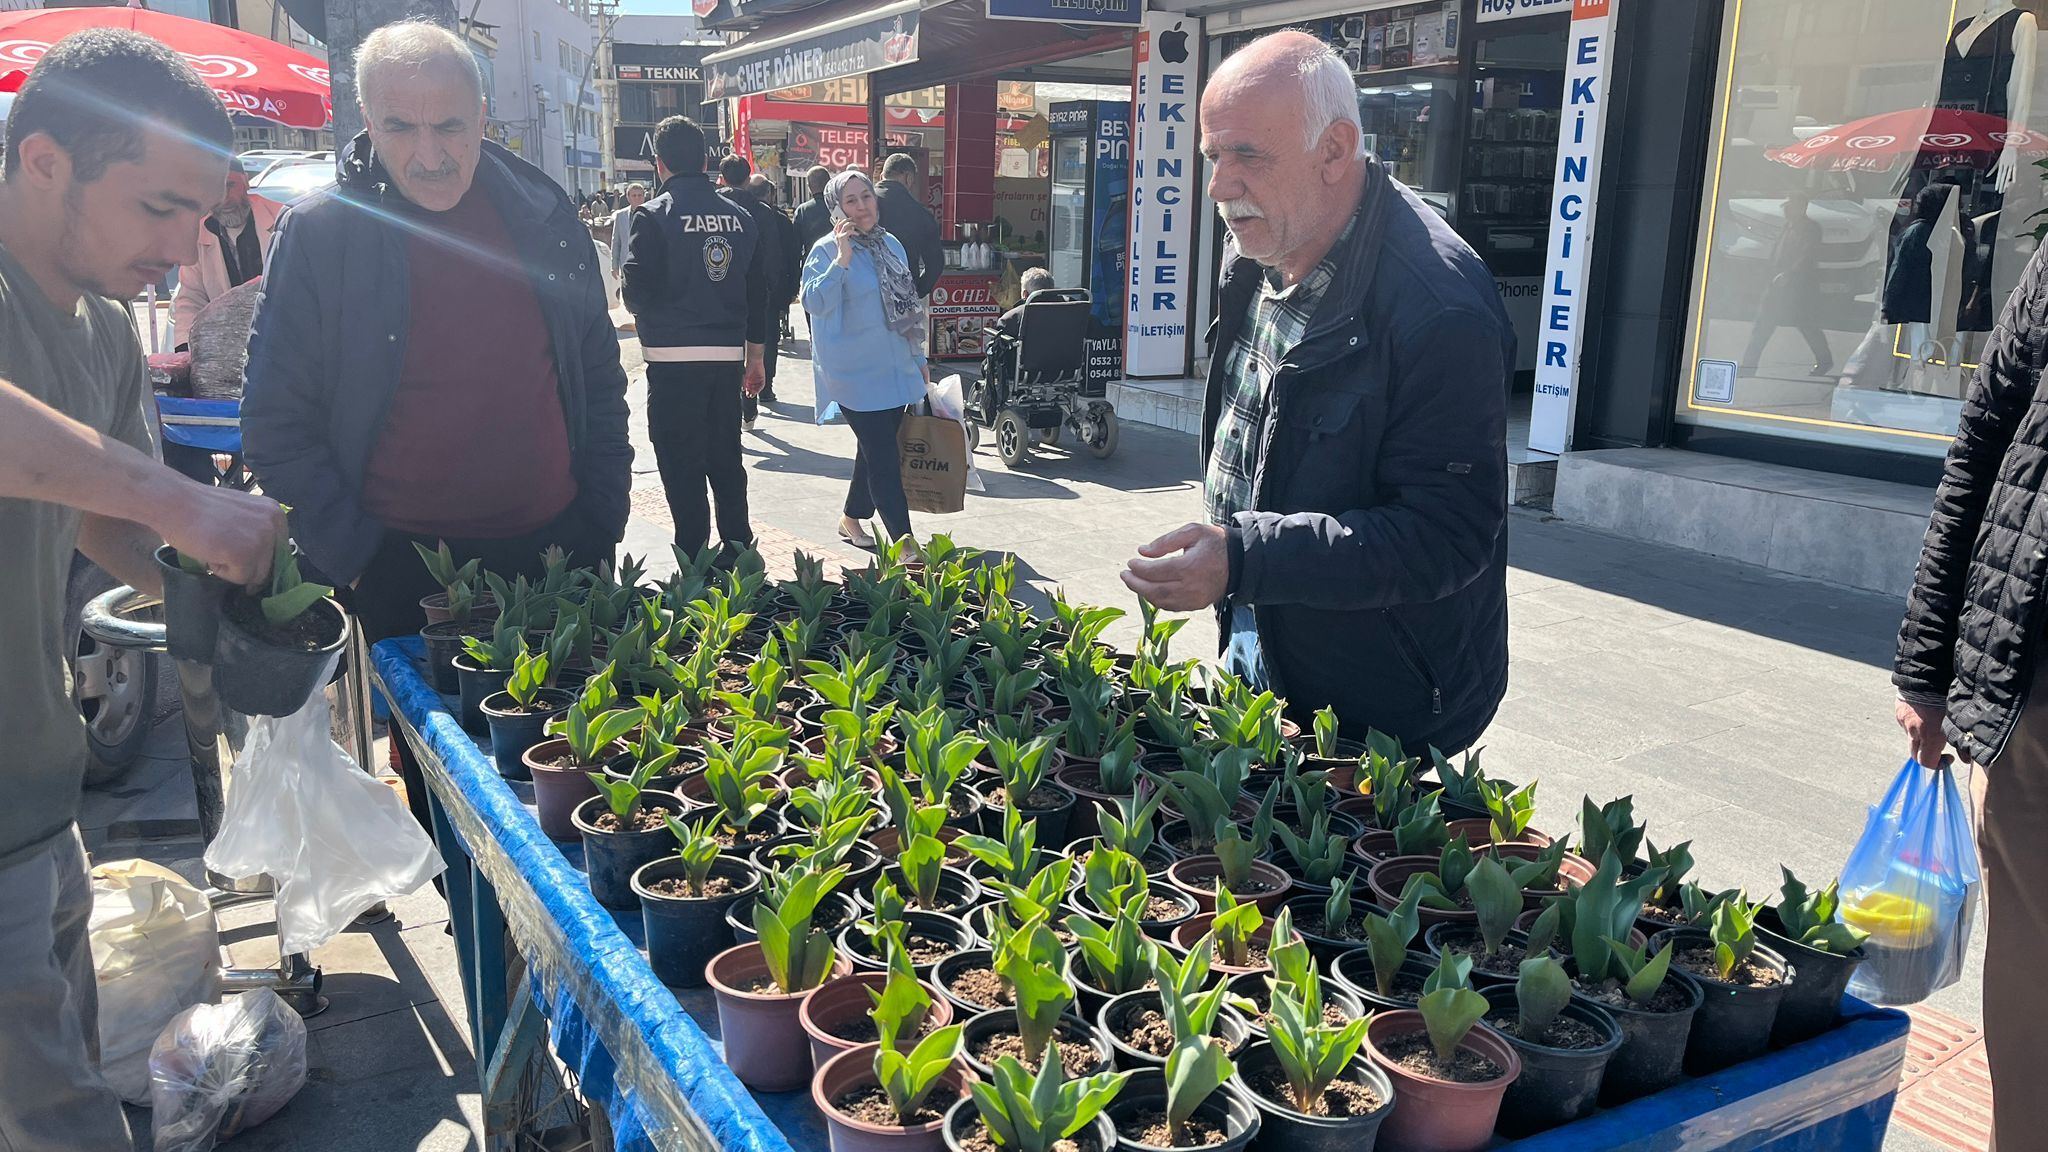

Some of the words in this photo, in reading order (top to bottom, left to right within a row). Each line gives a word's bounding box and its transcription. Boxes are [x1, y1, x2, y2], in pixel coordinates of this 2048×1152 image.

[738, 60, 771, 92] CHEF
[774, 47, 824, 87] DÖNER
[680, 214, 744, 233] ZABITA
[1091, 338, 1117, 352] YAYLA
[1090, 356, 1112, 366] 0532
[1089, 369, 1112, 379] 0544
